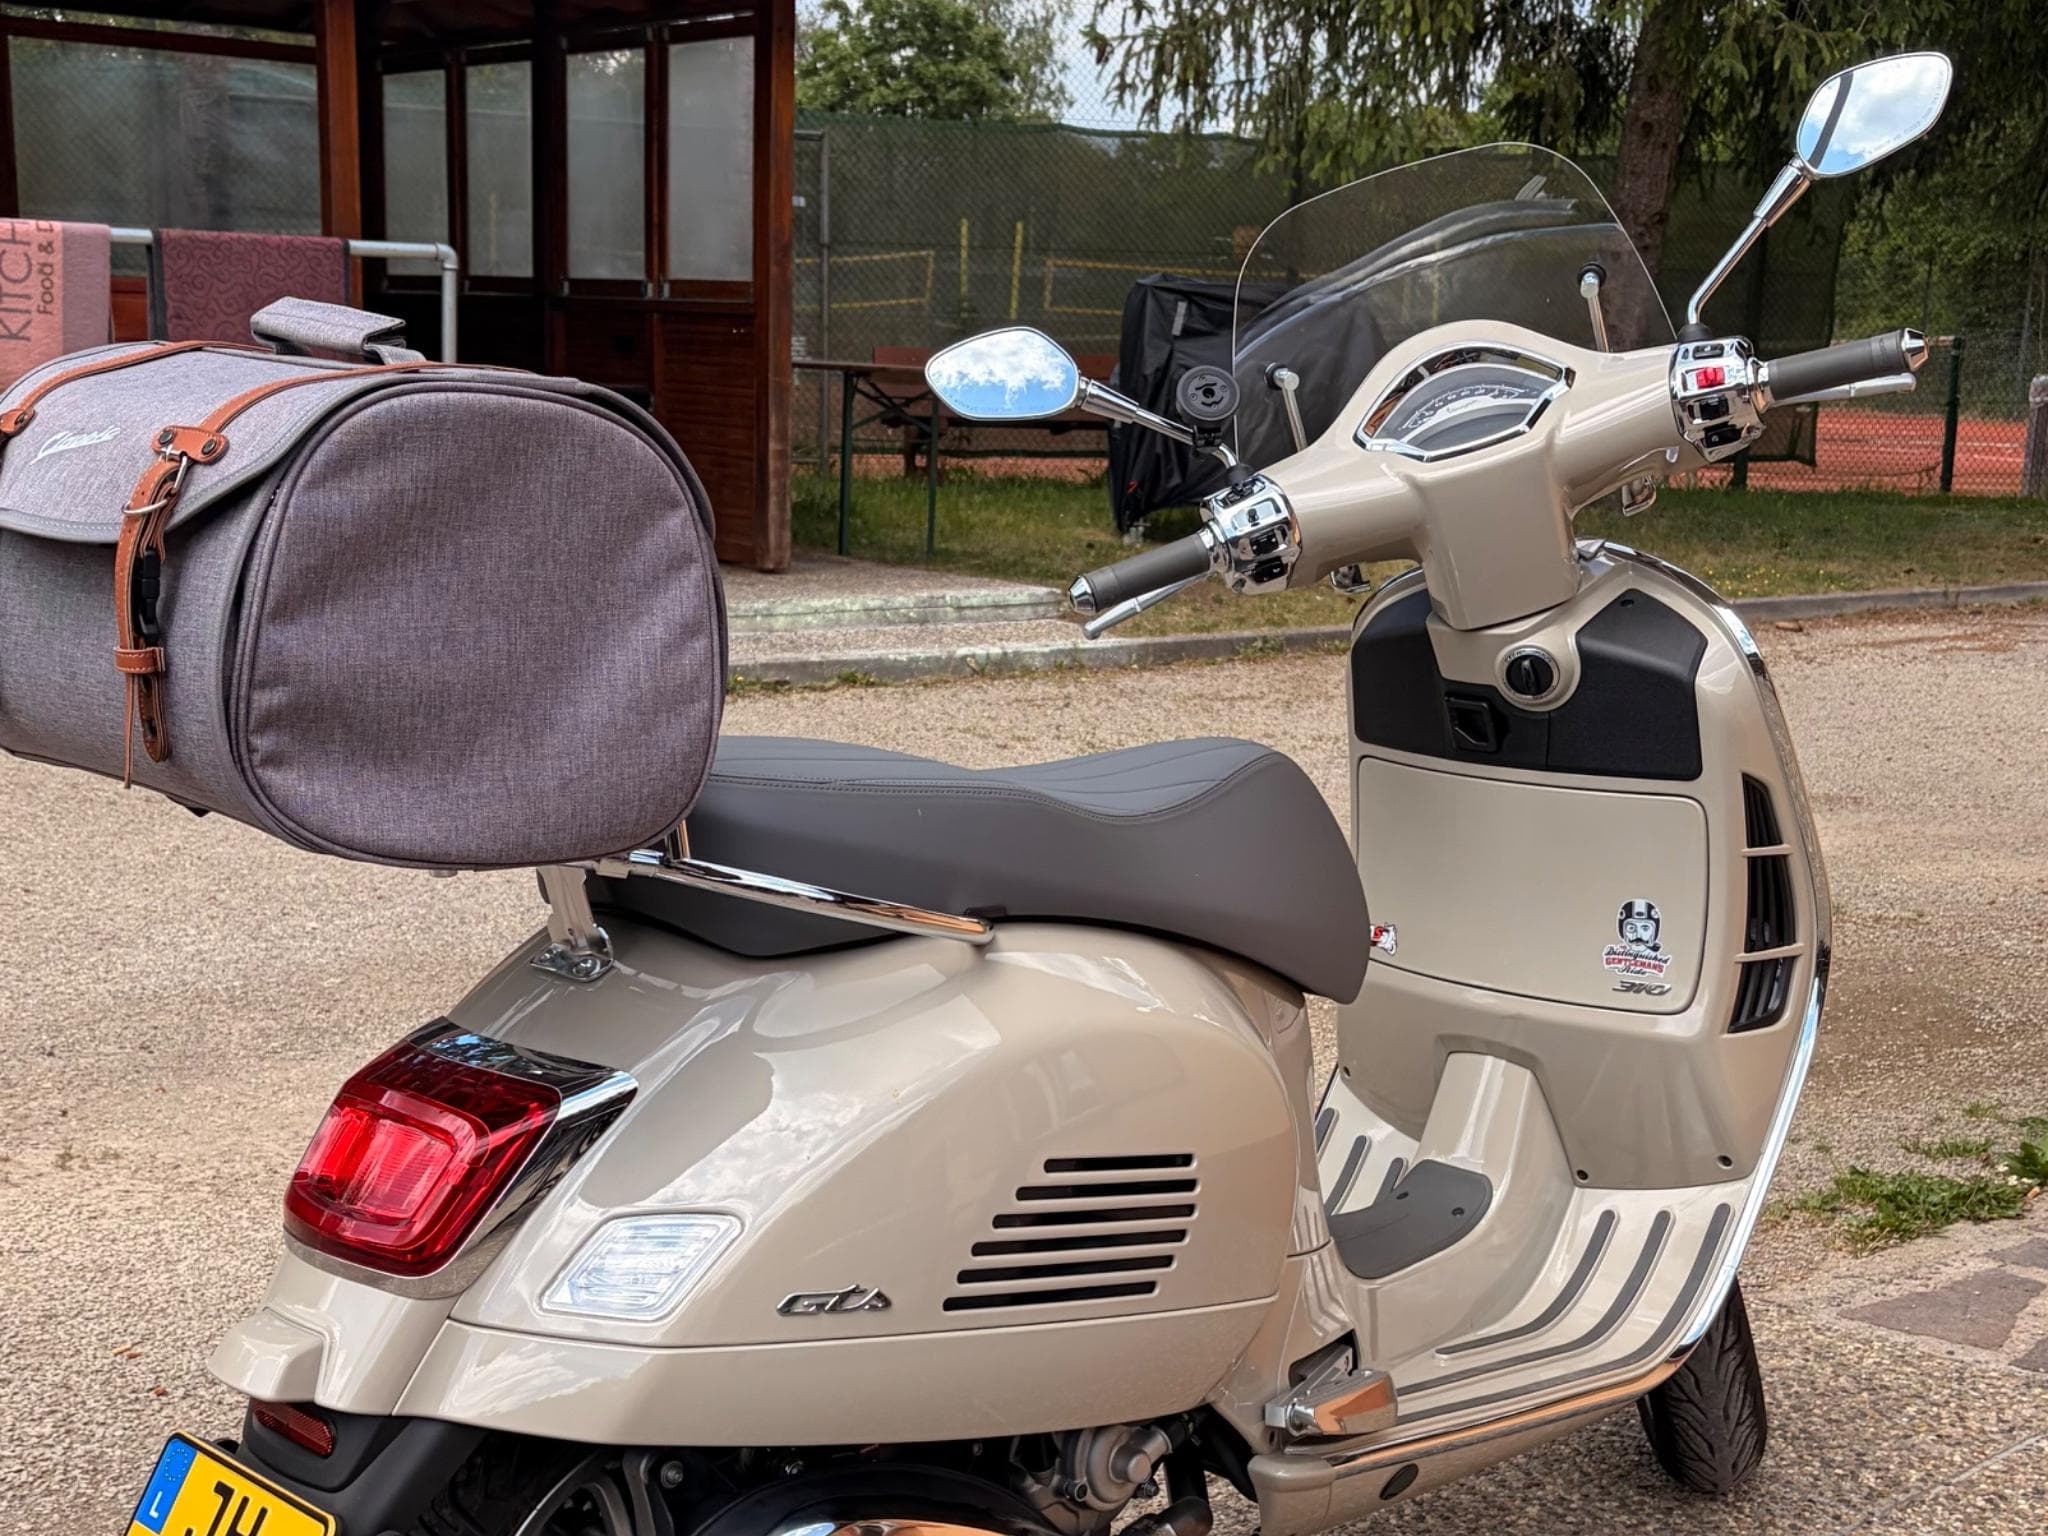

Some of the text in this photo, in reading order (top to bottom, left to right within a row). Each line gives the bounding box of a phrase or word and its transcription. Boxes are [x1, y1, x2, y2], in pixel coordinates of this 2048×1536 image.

[38, 241, 54, 254] &
[37, 262, 54, 315] Food
[149, 1491, 163, 1519] L
